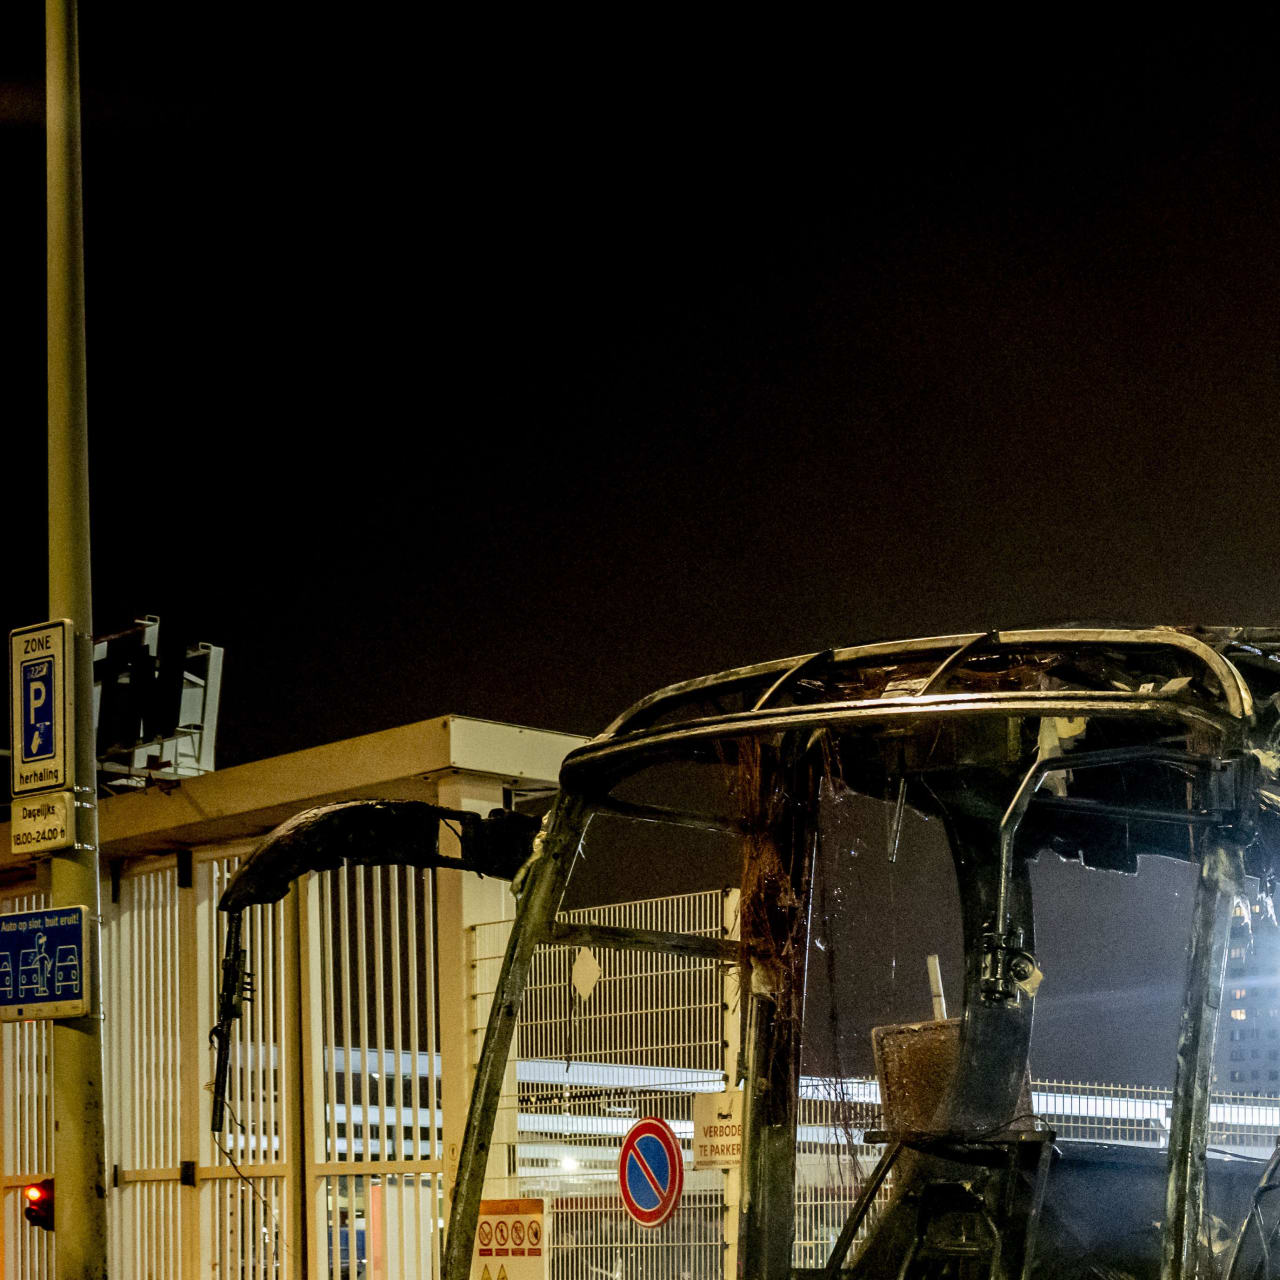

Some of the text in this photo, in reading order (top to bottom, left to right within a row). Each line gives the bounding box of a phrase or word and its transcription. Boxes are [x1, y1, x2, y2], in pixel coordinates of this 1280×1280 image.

[24, 635, 51, 654] ZONE
[30, 681, 46, 724] P
[20, 768, 59, 785] herhaling
[22, 803, 55, 821] Dagelijks
[703, 1124, 742, 1138] VERBODE
[698, 1143, 742, 1157] TE PARKER
